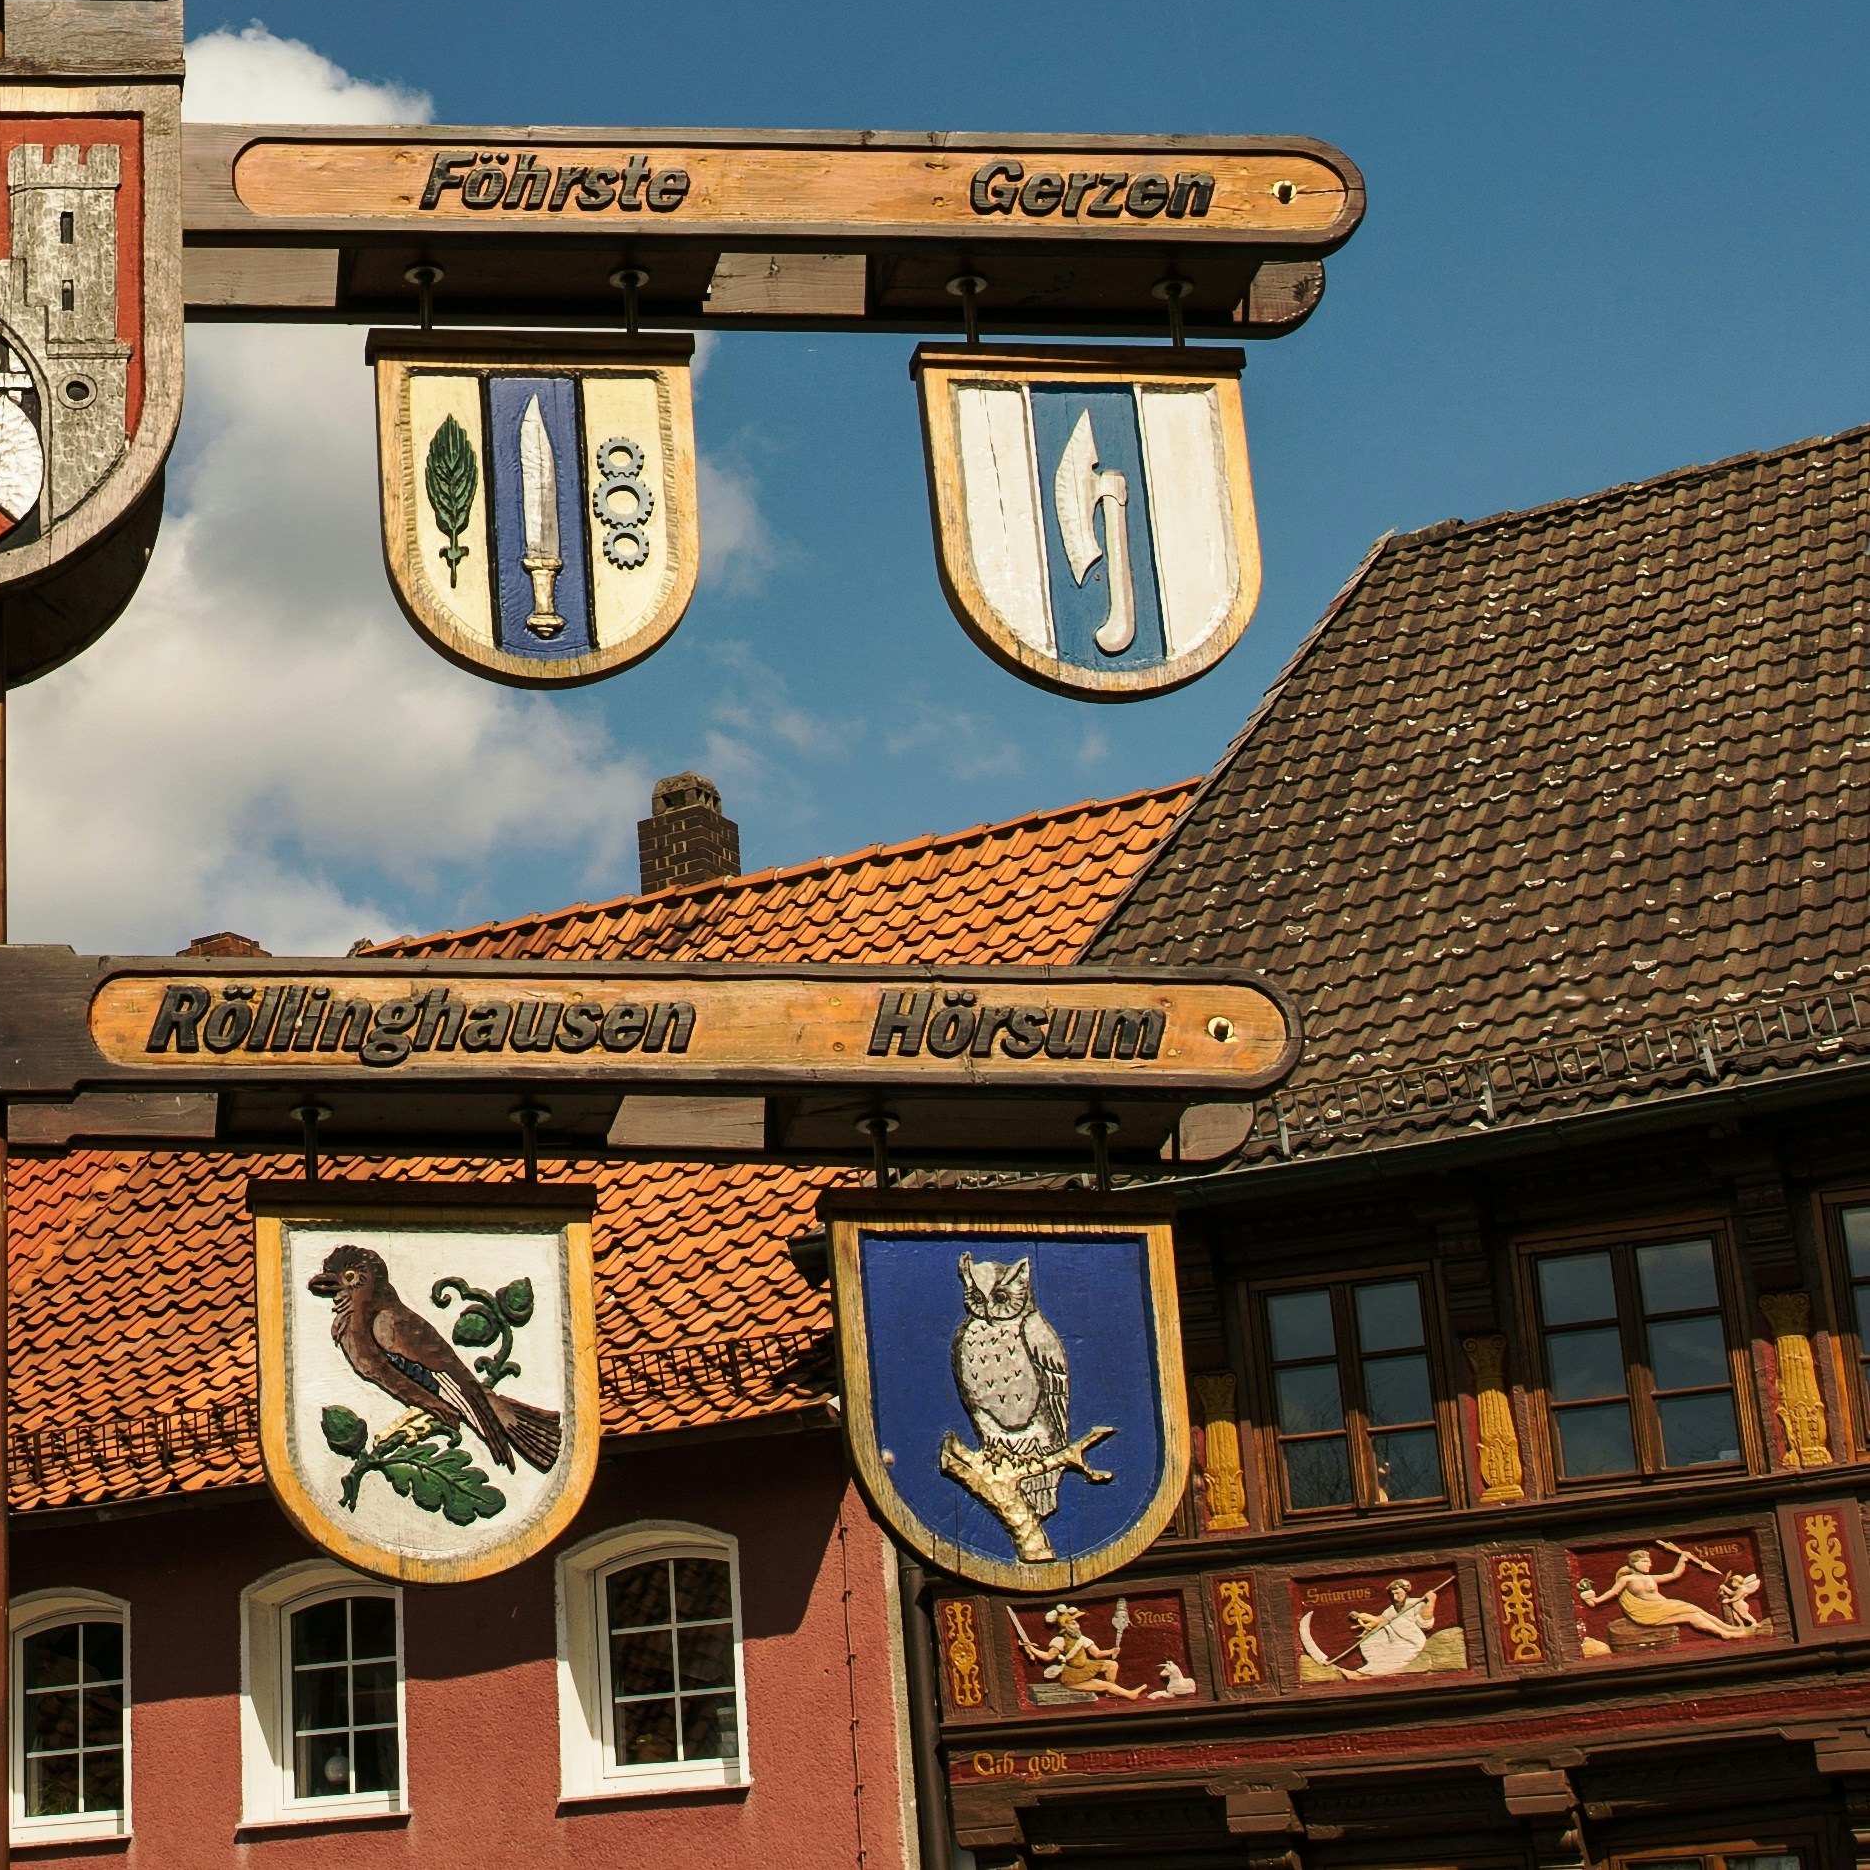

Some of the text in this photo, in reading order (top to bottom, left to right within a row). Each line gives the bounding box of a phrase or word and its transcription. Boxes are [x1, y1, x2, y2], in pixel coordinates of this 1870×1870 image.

[419, 150, 690, 213] Föhrste
[969, 159, 1215, 218] Gerzen
[146, 983, 696, 1067] Röllinghausen
[867, 990, 1167, 1060] Hörsum
